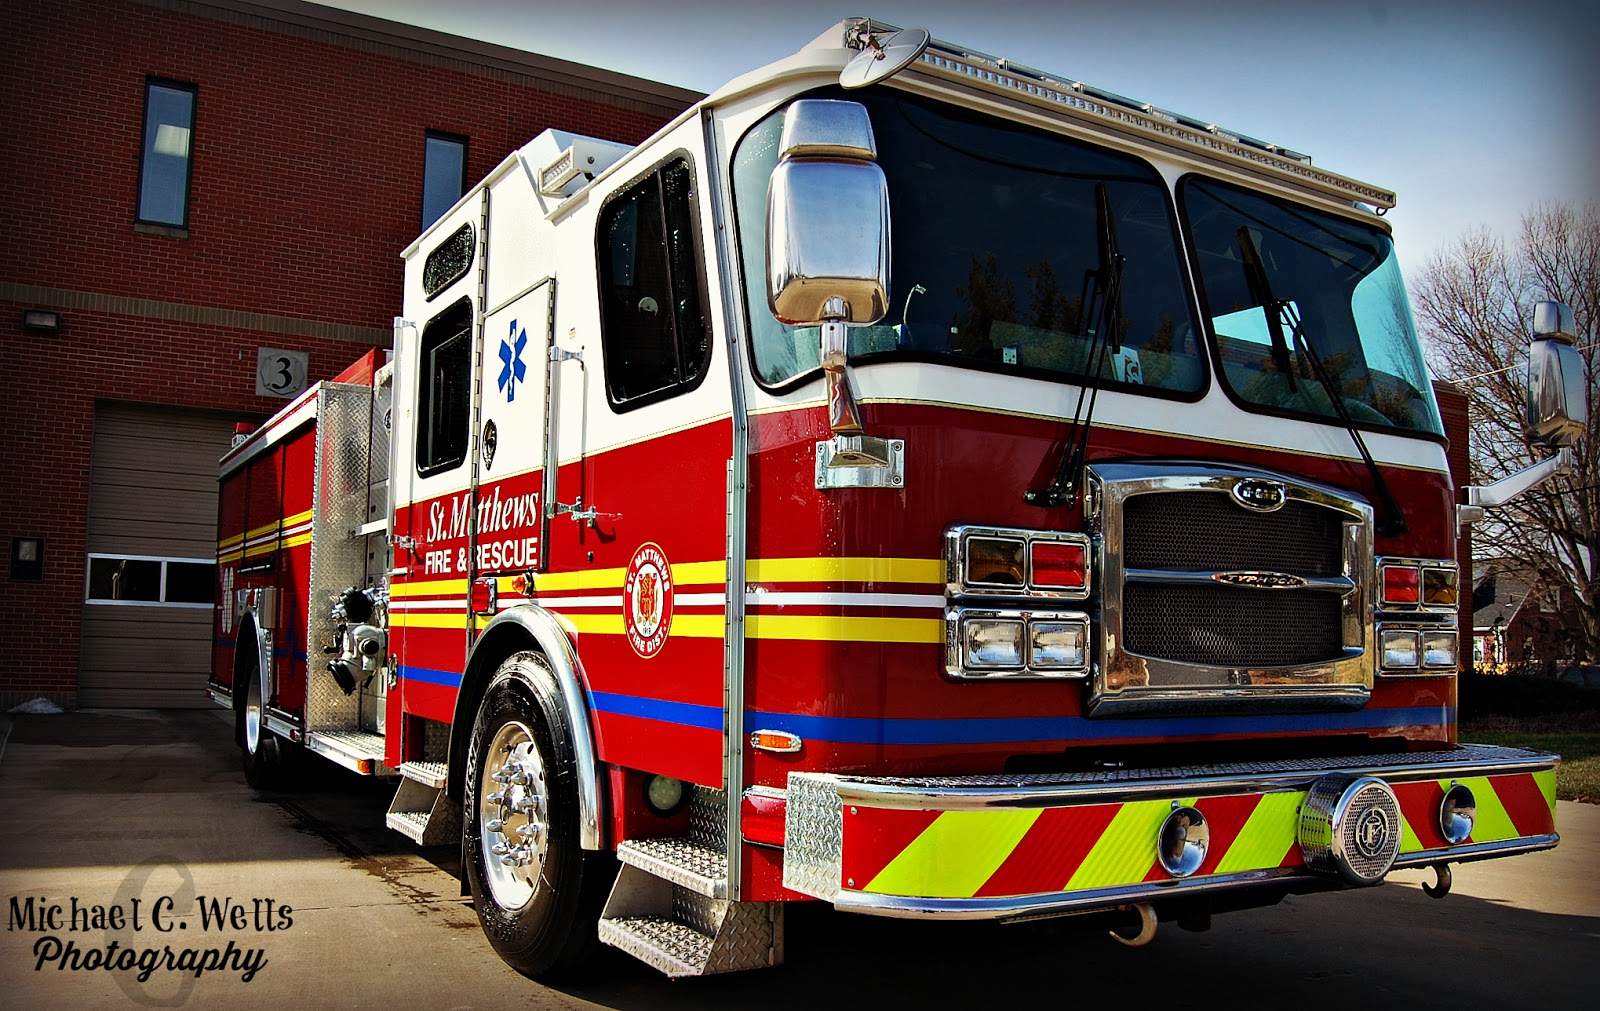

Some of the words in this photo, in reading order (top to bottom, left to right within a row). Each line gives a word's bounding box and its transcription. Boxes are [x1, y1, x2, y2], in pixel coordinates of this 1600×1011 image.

[271, 357, 293, 390] 3
[426, 500, 448, 543] St.
[447, 485, 540, 540] Mtthews
[424, 549, 452, 575] FIRE
[456, 547, 468, 573] &
[634, 548, 671, 593] MATTHEWS
[1227, 574, 1298, 585] TYPHOON
[629, 624, 646, 653] FIRE
[646, 625, 667, 653] DIST.
